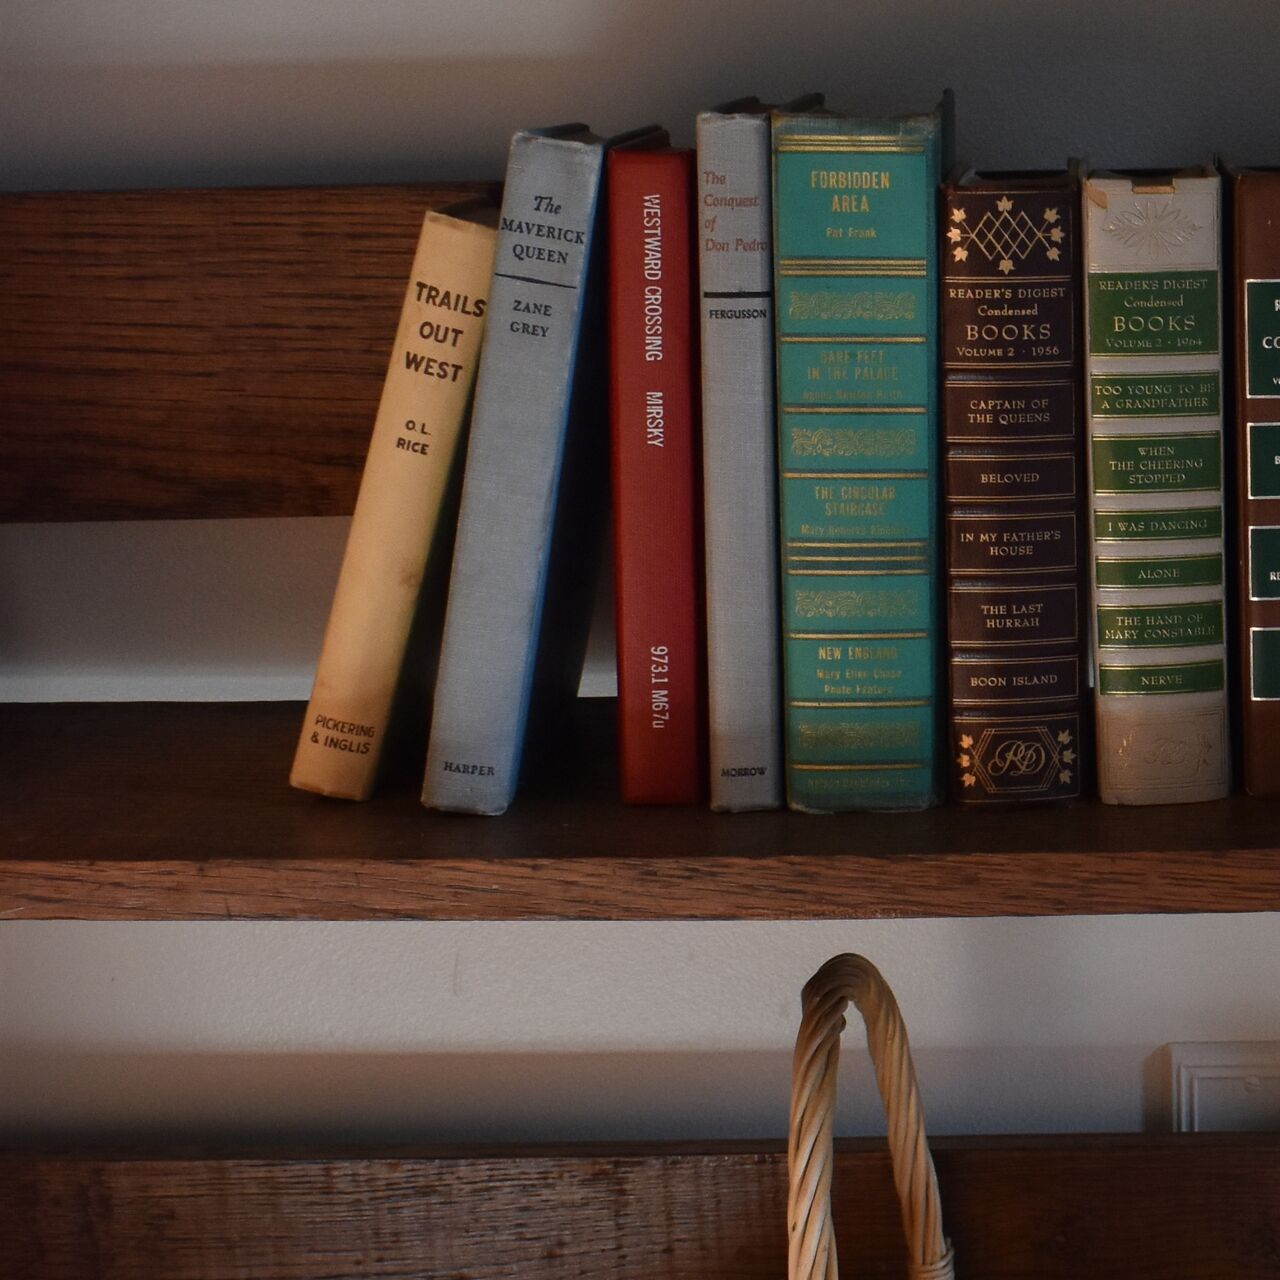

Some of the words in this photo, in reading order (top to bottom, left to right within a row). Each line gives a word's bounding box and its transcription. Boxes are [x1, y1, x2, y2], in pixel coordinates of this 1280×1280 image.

[704, 172, 726, 185] The
[811, 170, 890, 189] FORBIDDEN
[534, 195, 562, 215] The
[704, 194, 760, 211] Conquest
[832, 194, 869, 213] AREA
[705, 216, 716, 232] of
[501, 217, 585, 245] MAVERICK
[643, 194, 662, 281] WESTWARD
[826, 227, 843, 238] Pat
[848, 227, 877, 239] Frank
[705, 239, 730, 252] Don
[735, 238, 767, 252] Pedro
[512, 244, 569, 265] QUEEN
[1099, 280, 1160, 291] READER'S
[1163, 279, 1208, 290] DIGEST
[416, 281, 487, 318] TRAILS
[949, 288, 1013, 299] READER'S
[1017, 287, 1066, 298] DIGEST
[513, 299, 552, 317] ZANE
[1124, 295, 1184, 308] Condensed
[709, 309, 767, 320] FERGUSSON
[977, 304, 1038, 316] Condensed
[510, 320, 550, 338] GREY
[644, 284, 663, 362] CROSSING
[1114, 315, 1196, 332] BOOKS
[419, 320, 464, 348] OUT
[966, 323, 1051, 341] BOOKS
[1105, 338, 1152, 348] VOLUME
[1155, 338, 1163, 348] 2
[957, 347, 1004, 357] VOLUME
[1007, 347, 1015, 357] 2
[1031, 346, 1060, 356] 1956
[405, 350, 463, 383] WEST
[807, 367, 820, 380] IN
[1095, 385, 1122, 395] TOO
[1127, 384, 1172, 395] YOUNG
[1178, 384, 1195, 394] TO
[970, 400, 1026, 410] CAPTAIN
[1031, 399, 1049, 409] OF
[1101, 400, 1110, 409] A
[1116, 397, 1209, 409] GRANDFATHER
[646, 391, 664, 447] MIRSKY
[968, 413, 993, 424] THE
[999, 413, 1050, 425] QUEENS
[395, 436, 430, 456] RICE
[1137, 446, 1175, 456] WHEN
[1109, 460, 1134, 471] THE
[1139, 459, 1204, 470] CHEERING
[981, 473, 1040, 484] BELOVED
[1129, 474, 1186, 485] STOPPED
[814, 486, 833, 500] THE
[1108, 523, 1112, 532] I
[1118, 522, 1144, 531] WAS
[1150, 520, 1208, 531] DANCING
[960, 533, 974, 542] IN
[979, 532, 998, 542] MY
[1003, 531, 1061, 542] FATHER'S
[990, 546, 1034, 556] HOUSE
[1138, 568, 1181, 579] ALONE
[981, 605, 1006, 615] THE
[1012, 603, 1043, 614] LAST
[986, 618, 1039, 628] HURRAH
[1117, 616, 1141, 626] THE
[1146, 615, 1182, 625] HAND
[1188, 613, 1204, 623] OF
[1105, 629, 1139, 640] MARY
[1144, 625, 1215, 639] CONSTABLE
[818, 647, 841, 660] NEW
[651, 645, 669, 683] 973.1
[970, 676, 1007, 687] BOON
[1012, 674, 1058, 686] ISLAND
[1140, 674, 1183, 685] NERVE
[651, 689, 670, 729] M67u
[315, 714, 376, 738] PICKERING
[310, 731, 319, 744] &
[324, 735, 370, 754] INGLIS
[443, 761, 496, 776] HARPER
[721, 767, 768, 777] MORROW
